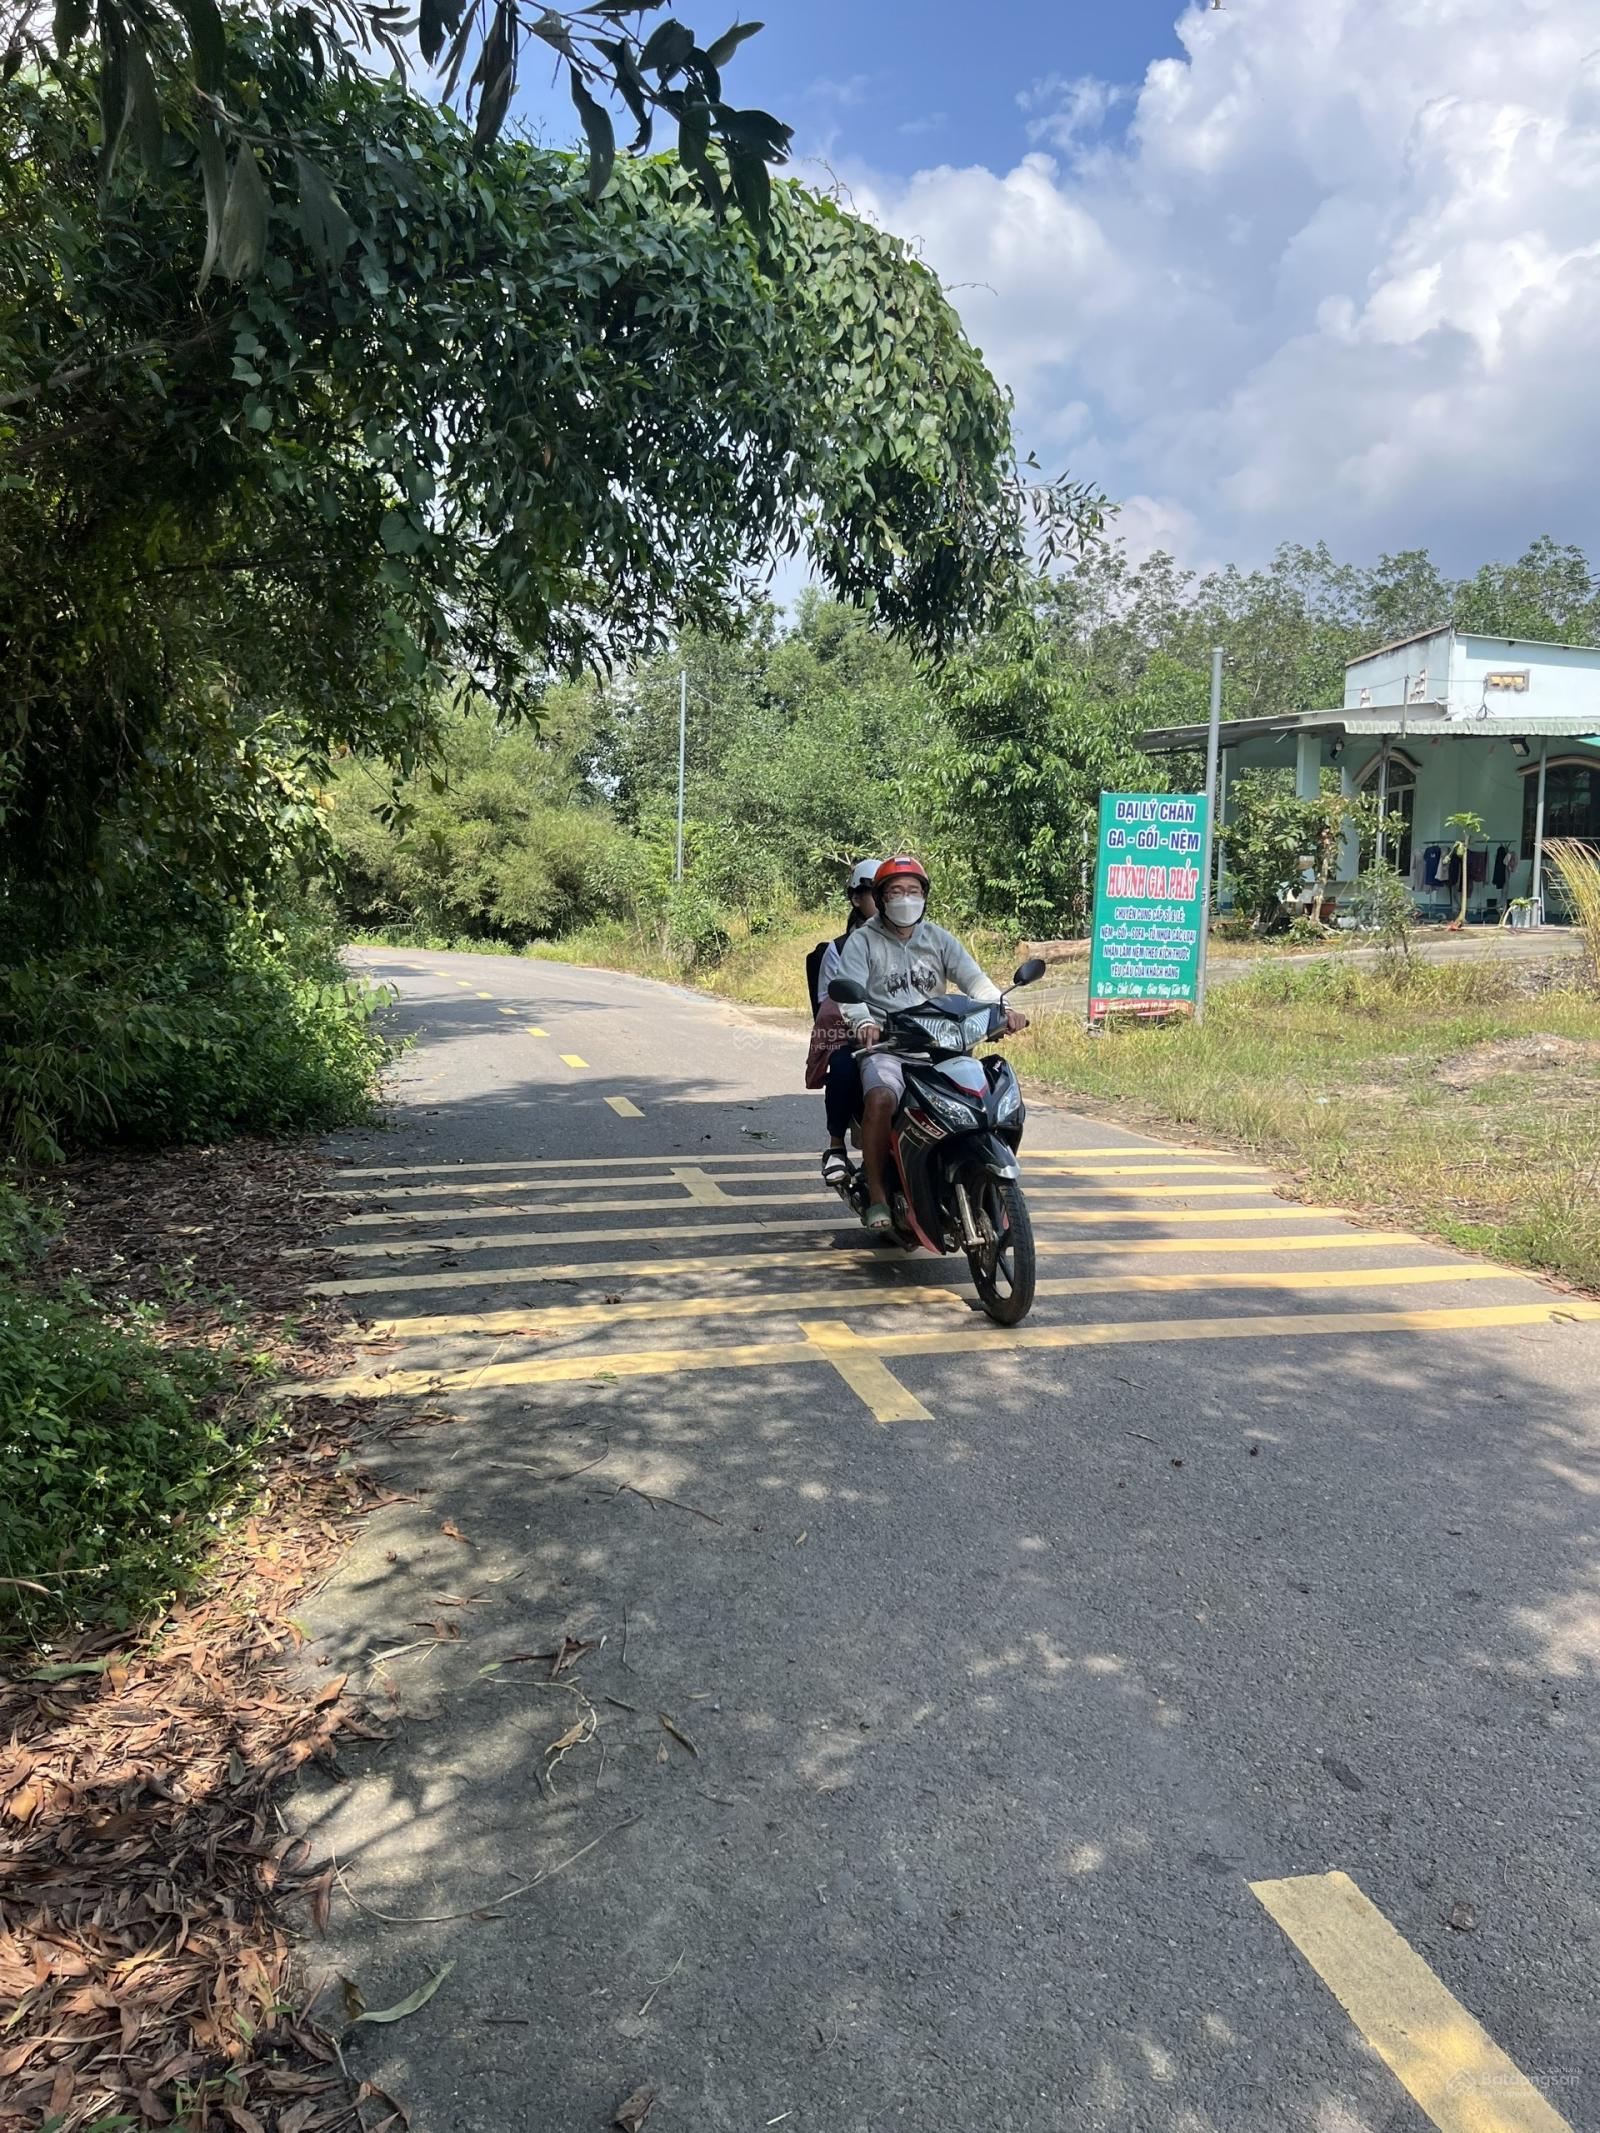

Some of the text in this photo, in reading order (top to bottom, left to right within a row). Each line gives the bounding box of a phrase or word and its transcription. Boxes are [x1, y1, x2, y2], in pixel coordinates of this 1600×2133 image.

[1117, 799, 1195, 823] ĐẠI LÝ CHĂN
[1108, 829, 1125, 848] GA
[1137, 825, 1159, 849] GỐI
[1169, 828, 1200, 854] NỆM
[1148, 866, 1166, 899] GIA
[1168, 858, 1199, 901] PHÁT
